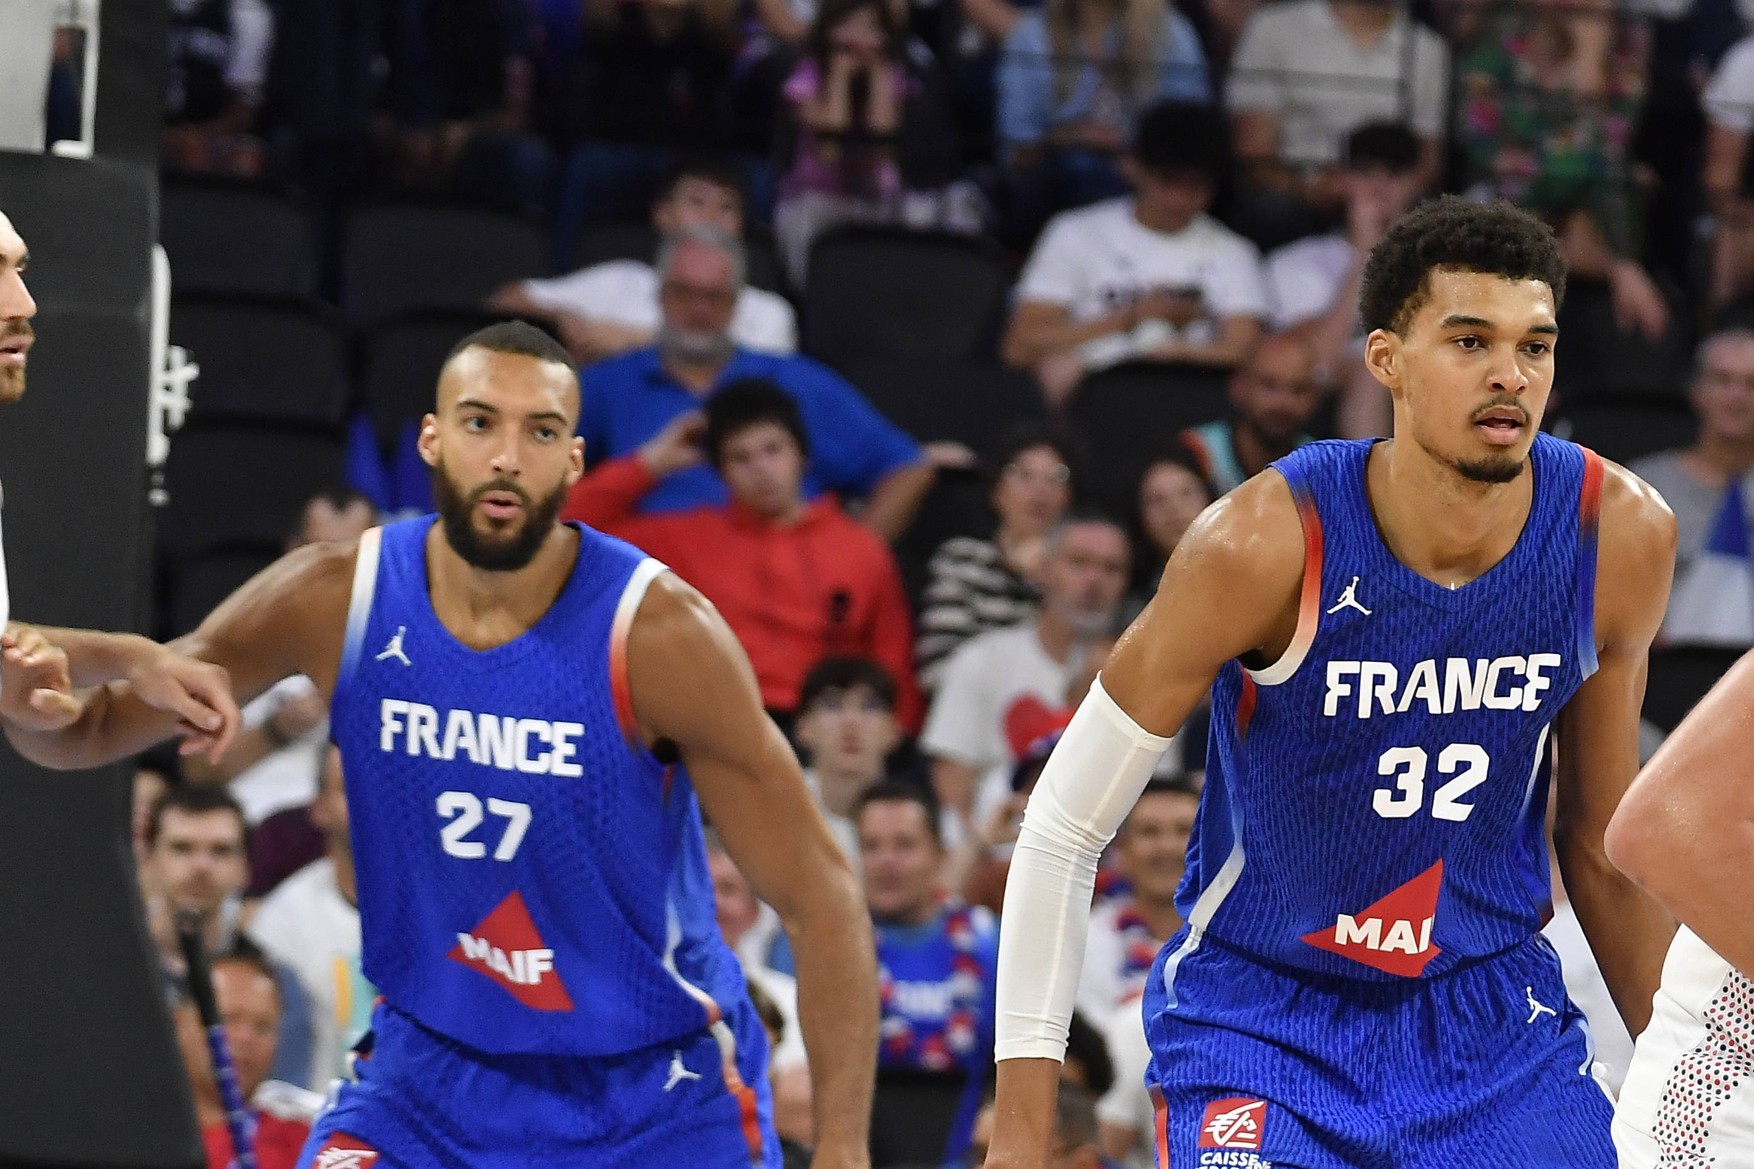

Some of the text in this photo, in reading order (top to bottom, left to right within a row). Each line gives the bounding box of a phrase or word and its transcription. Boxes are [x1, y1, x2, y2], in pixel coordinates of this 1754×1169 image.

[1323, 653, 1561, 719] FRANCE
[381, 698, 585, 778] FRANCE
[1372, 743, 1490, 822] 32
[436, 791, 533, 862] 27
[457, 932, 554, 985] MAIF
[1334, 913, 1436, 955] MAI
[1200, 1152, 1260, 1166] CAISSE
